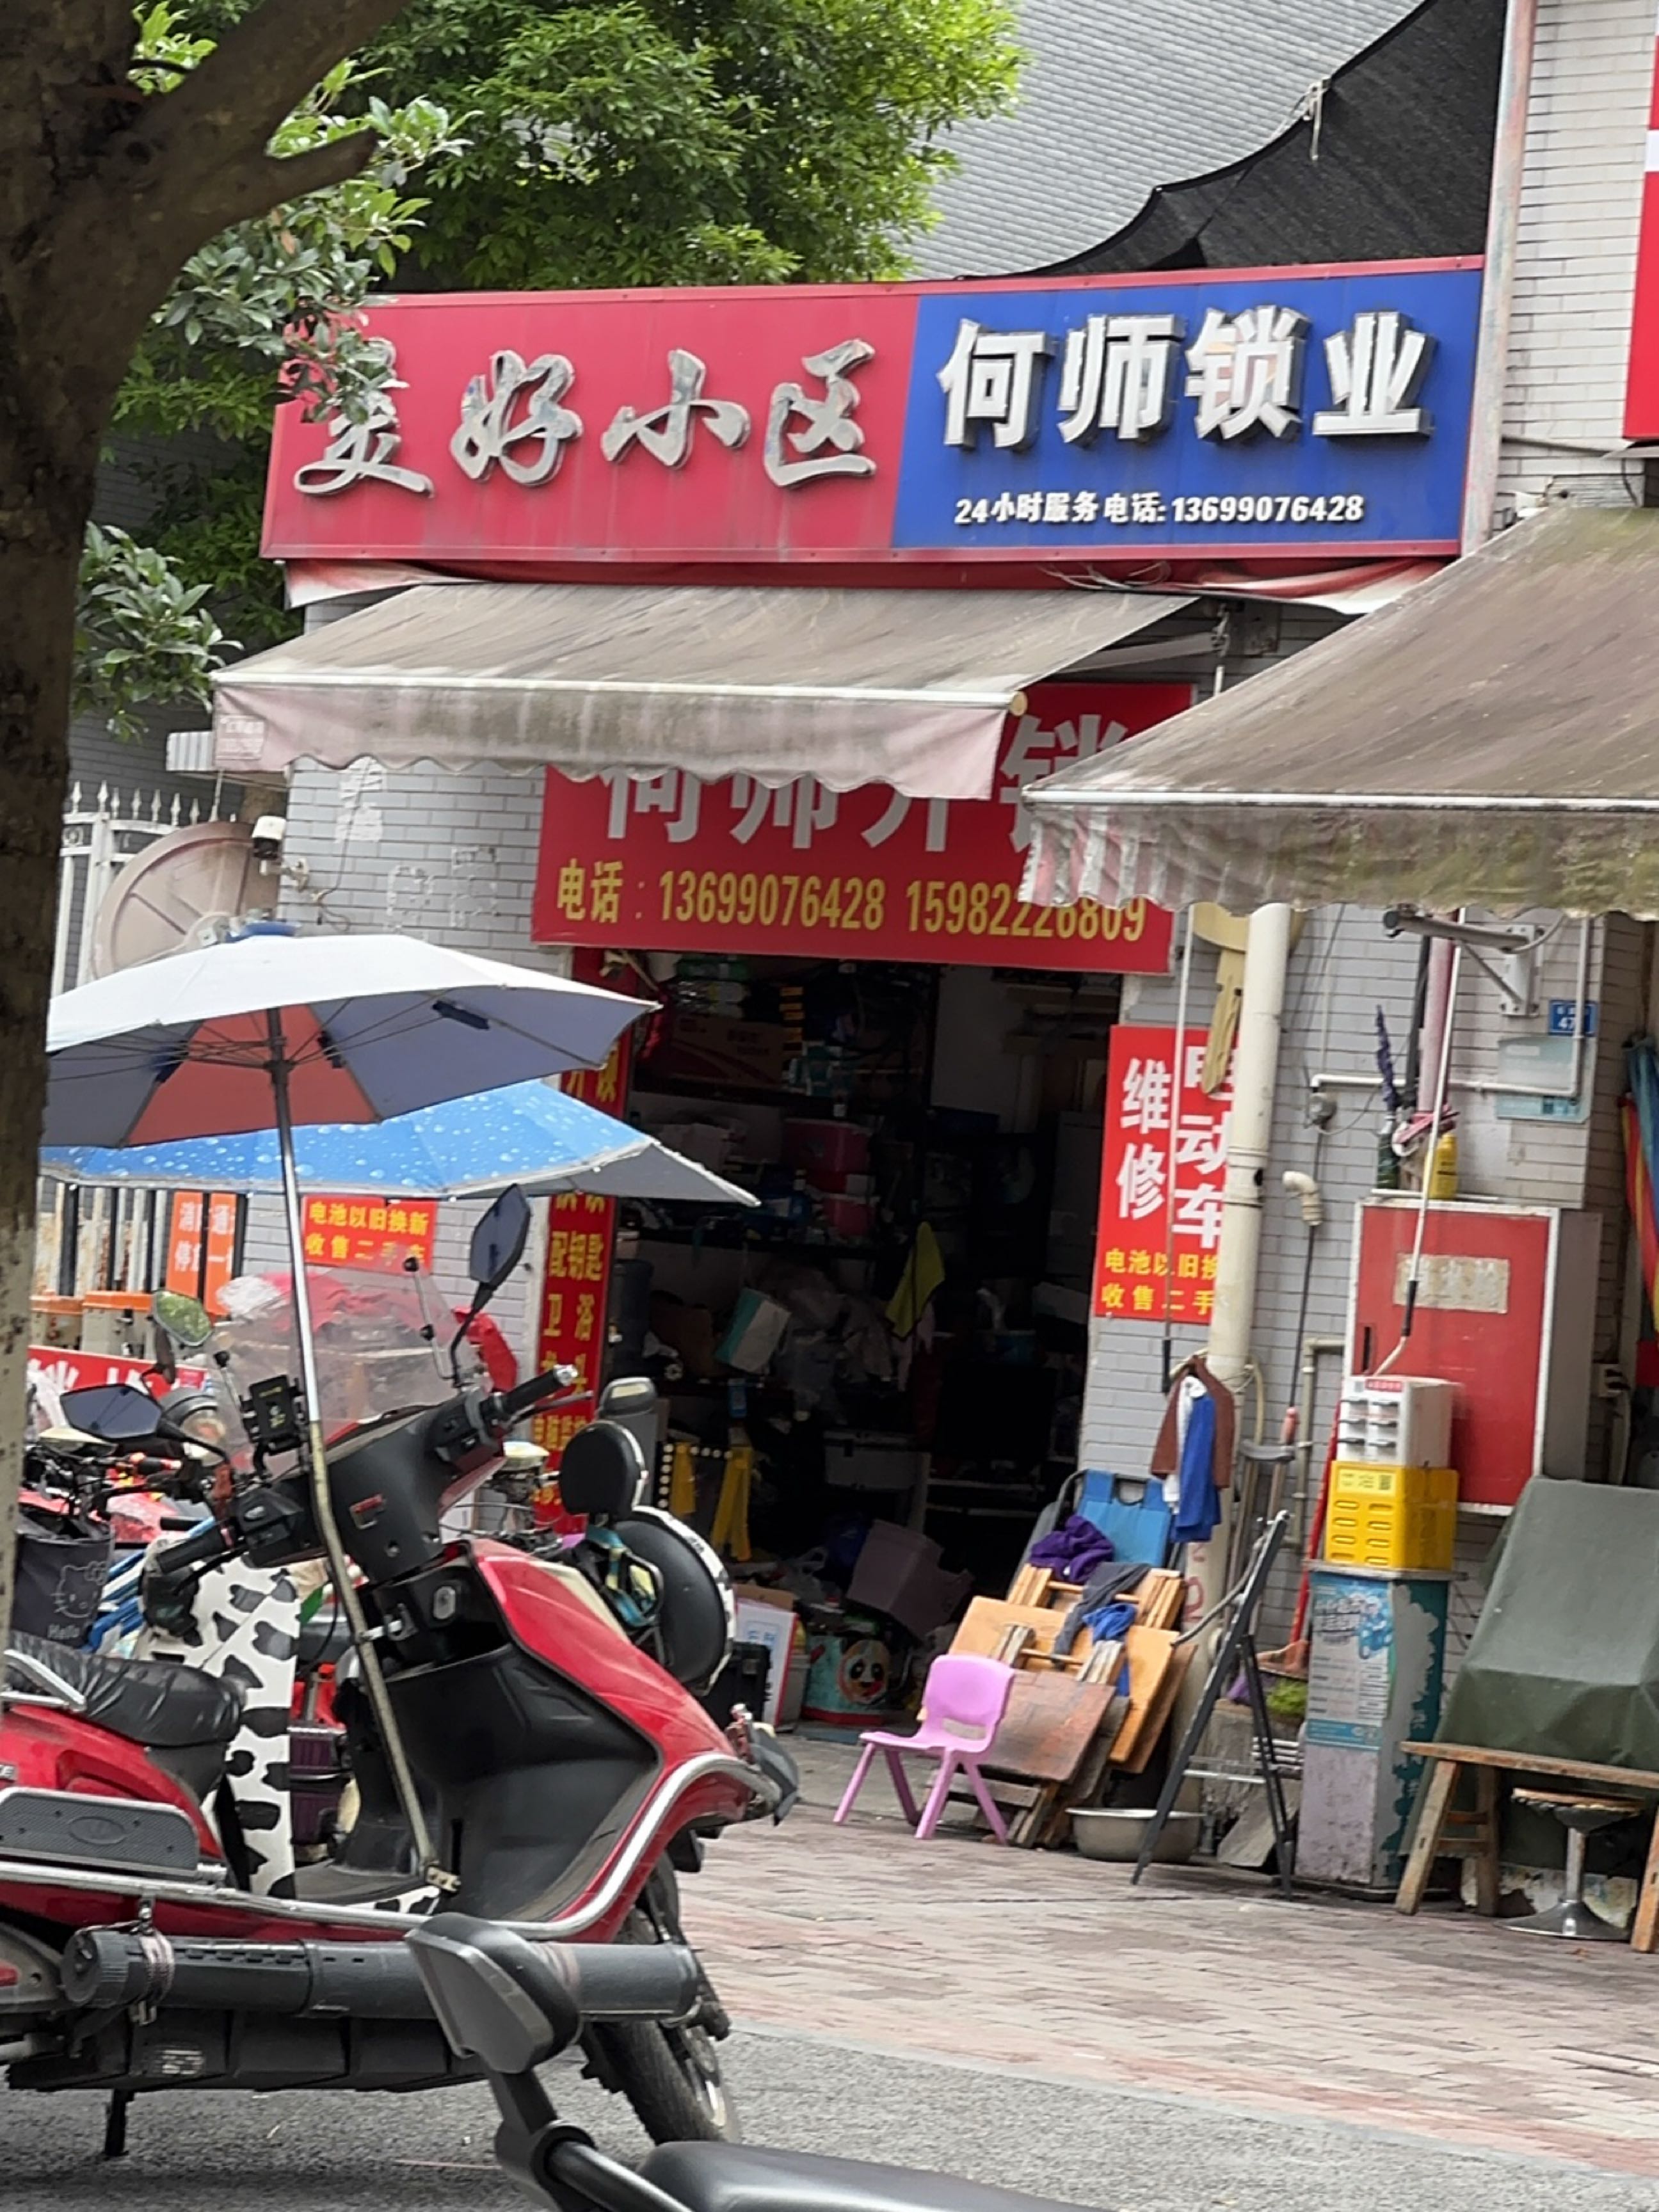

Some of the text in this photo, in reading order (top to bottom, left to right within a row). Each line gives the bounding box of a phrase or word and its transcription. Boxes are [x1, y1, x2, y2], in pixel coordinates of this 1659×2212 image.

[937, 305, 1435, 451] 何师锁业
[1116, 1057, 1172, 1220] 维修
[308, 1201, 429, 1236] 电池以旧换新
